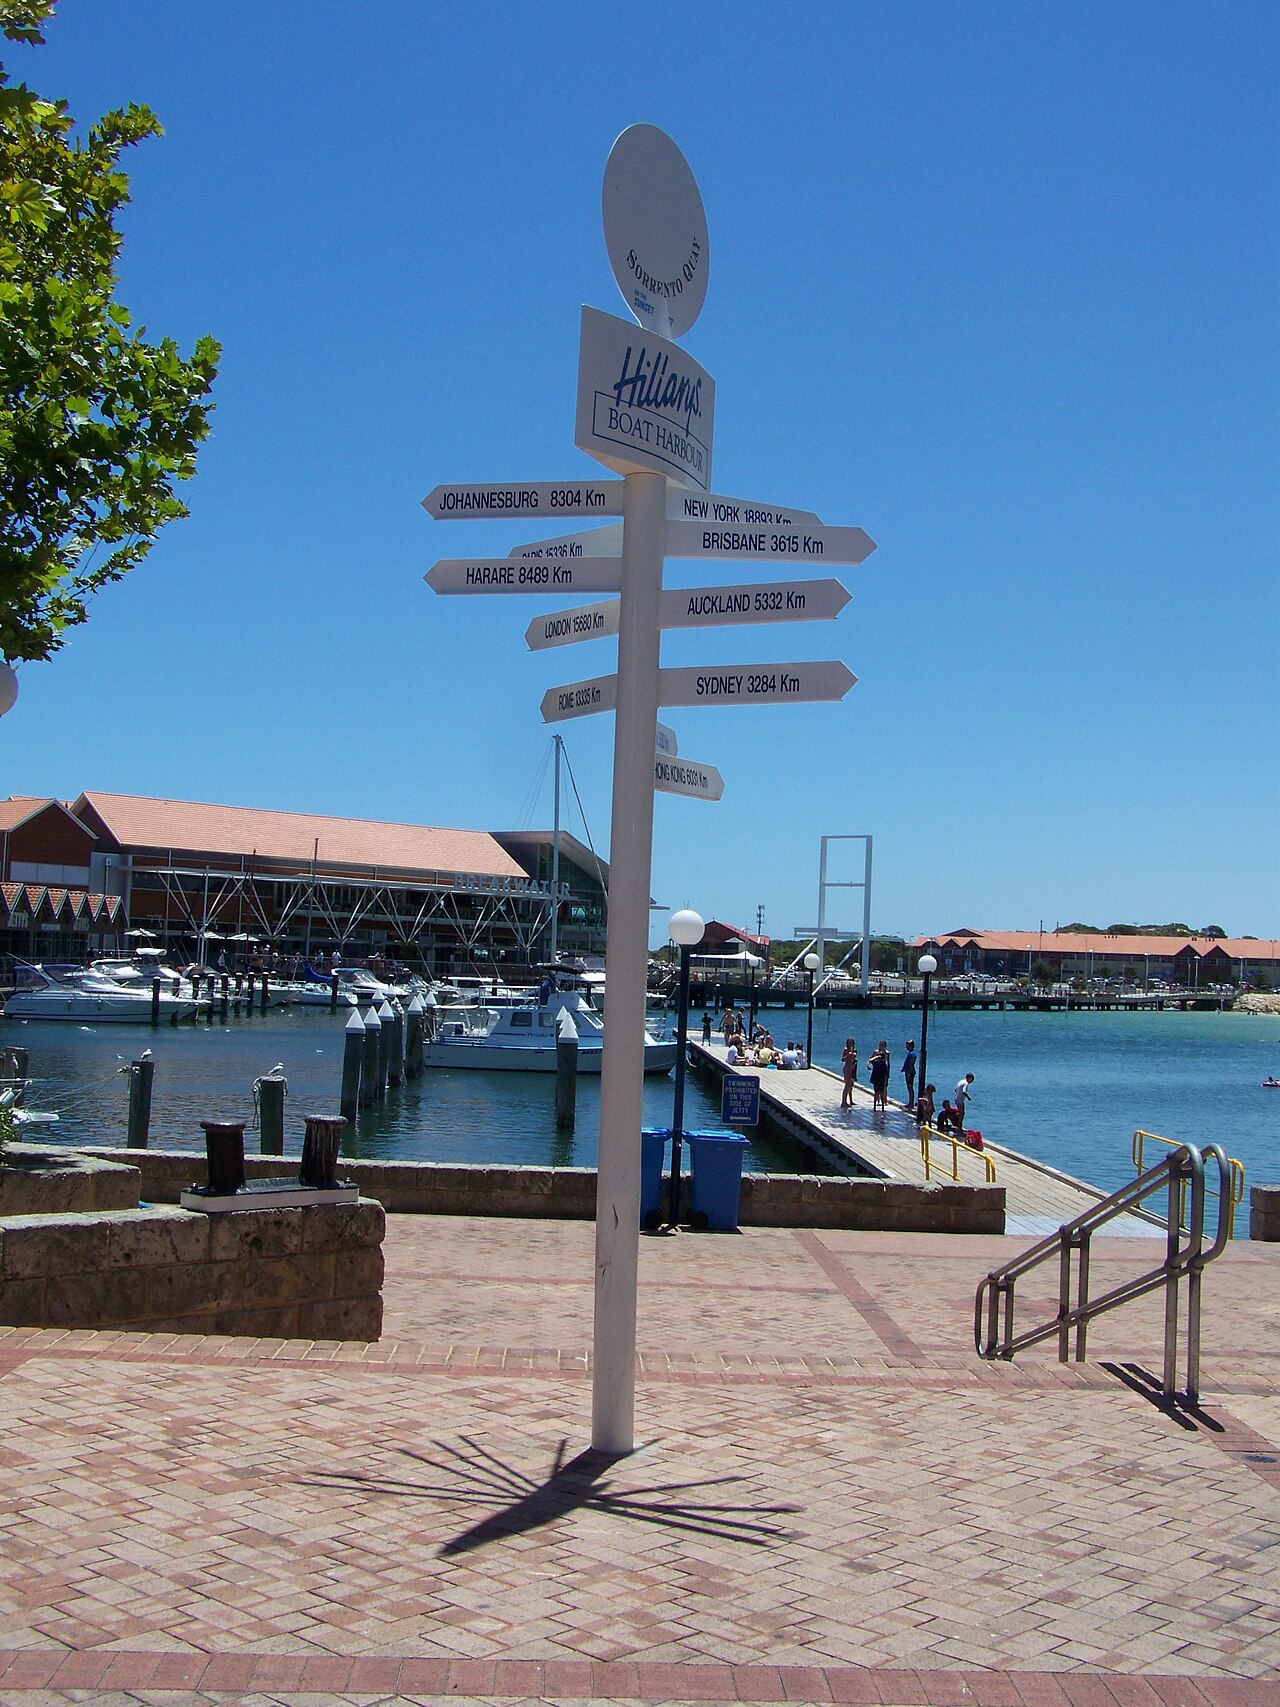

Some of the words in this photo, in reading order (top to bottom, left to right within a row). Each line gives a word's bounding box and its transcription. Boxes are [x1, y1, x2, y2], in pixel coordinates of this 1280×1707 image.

[626, 249, 684, 298] SORRENTO
[682, 236, 701, 282] QUAY
[608, 407, 653, 442] BOAT
[655, 424, 703, 474] HARBOUR
[439, 490, 539, 511] JOHANNESBURG
[550, 489, 582, 508] 8304
[585, 488, 606, 507] Km
[684, 498, 709, 519] NEW
[712, 503, 740, 523] YORK
[569, 542, 583, 558] Km
[702, 532, 766, 551] BRISBANE
[770, 535, 799, 553] 3615
[803, 536, 824, 553] Km
[466, 567, 515, 585] HARARE
[518, 566, 549, 584] 8489
[553, 566, 572, 583] Km
[687, 595, 751, 615] AUCKLAND
[754, 592, 783, 610] 5332
[786, 591, 806, 609] Km
[544, 618, 571, 638] LONDON
[593, 612, 605, 629] Km
[696, 676, 743, 695] SYDNEY
[747, 675, 776, 693] 3284
[780, 673, 800, 692] Km
[558, 692, 574, 711] ROME
[591, 686, 601, 702] Km
[670, 764, 687, 784] KONG
[698, 771, 709, 788] Km
[725, 1086, 758, 1094] PROHIBITED
